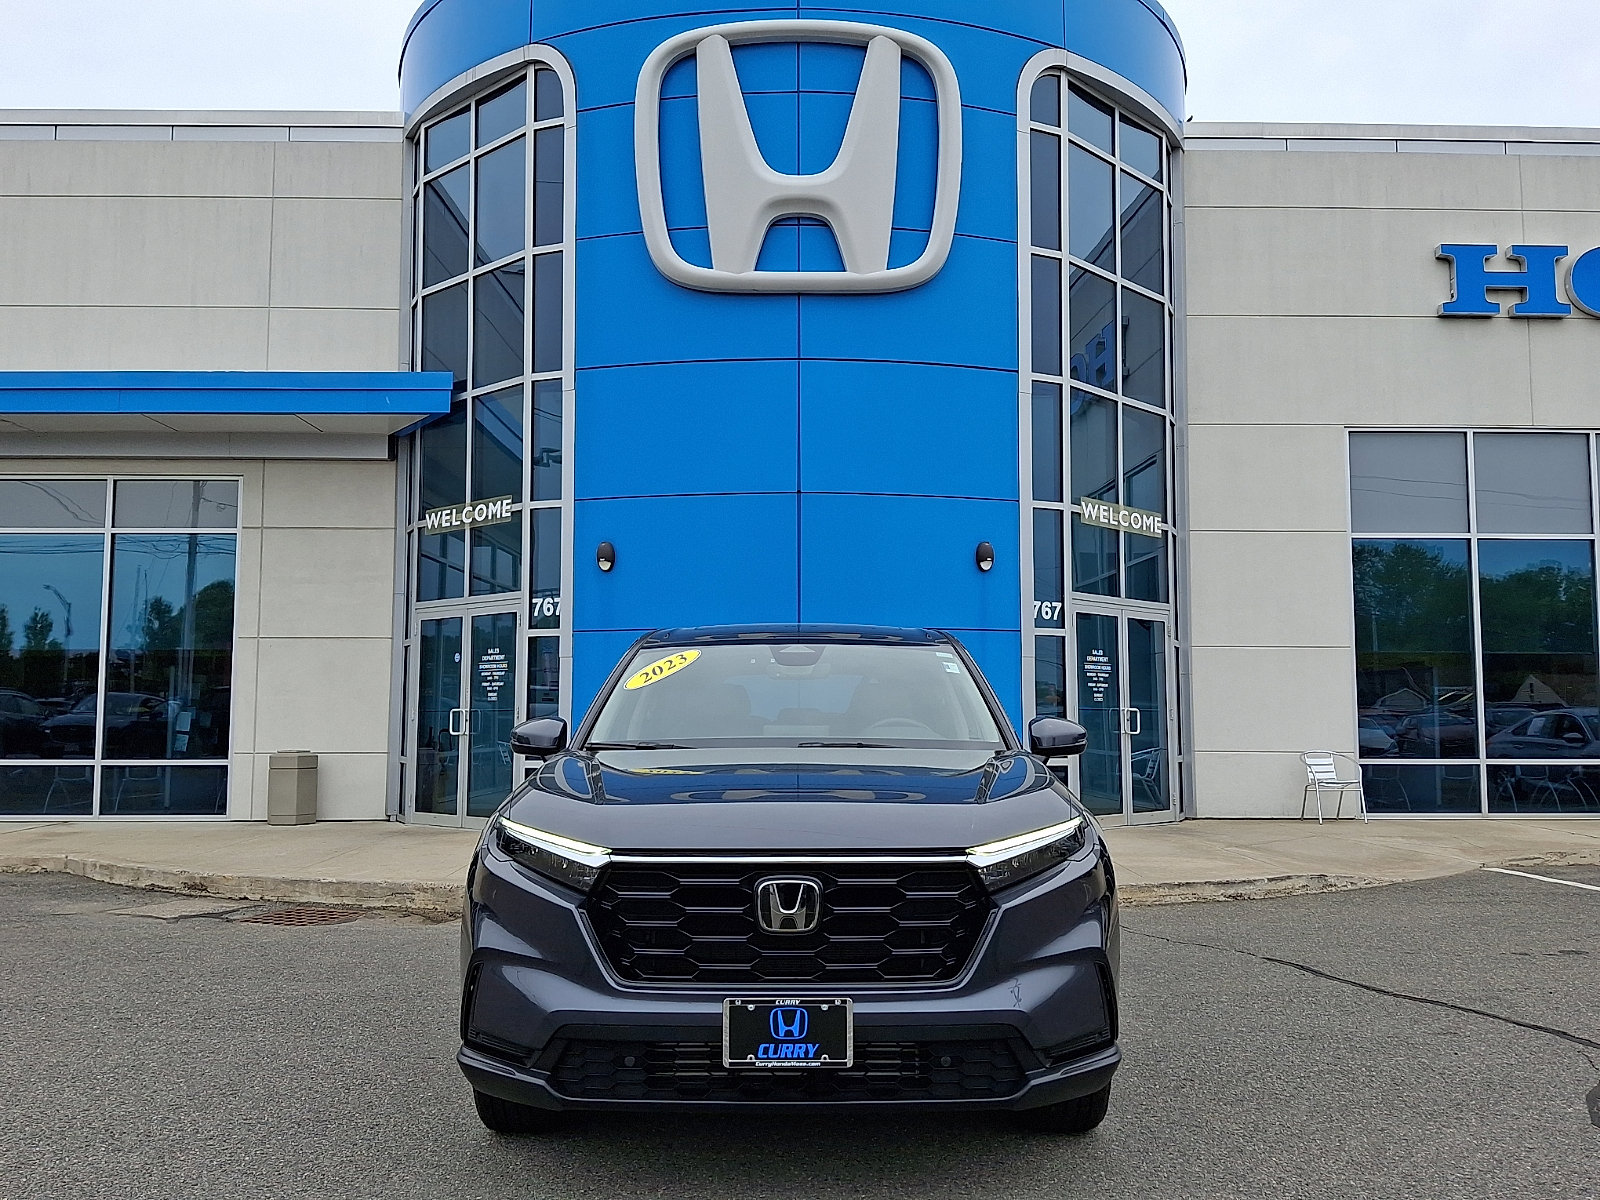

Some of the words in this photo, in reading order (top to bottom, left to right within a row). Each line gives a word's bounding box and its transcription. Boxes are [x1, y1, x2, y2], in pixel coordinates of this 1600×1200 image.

[425, 499, 512, 530] WELCOME
[1081, 501, 1162, 534] WELCOME
[532, 597, 561, 617] 767
[1033, 600, 1062, 621] 767
[640, 654, 688, 684] 2023
[757, 1043, 820, 1058] CURRY
